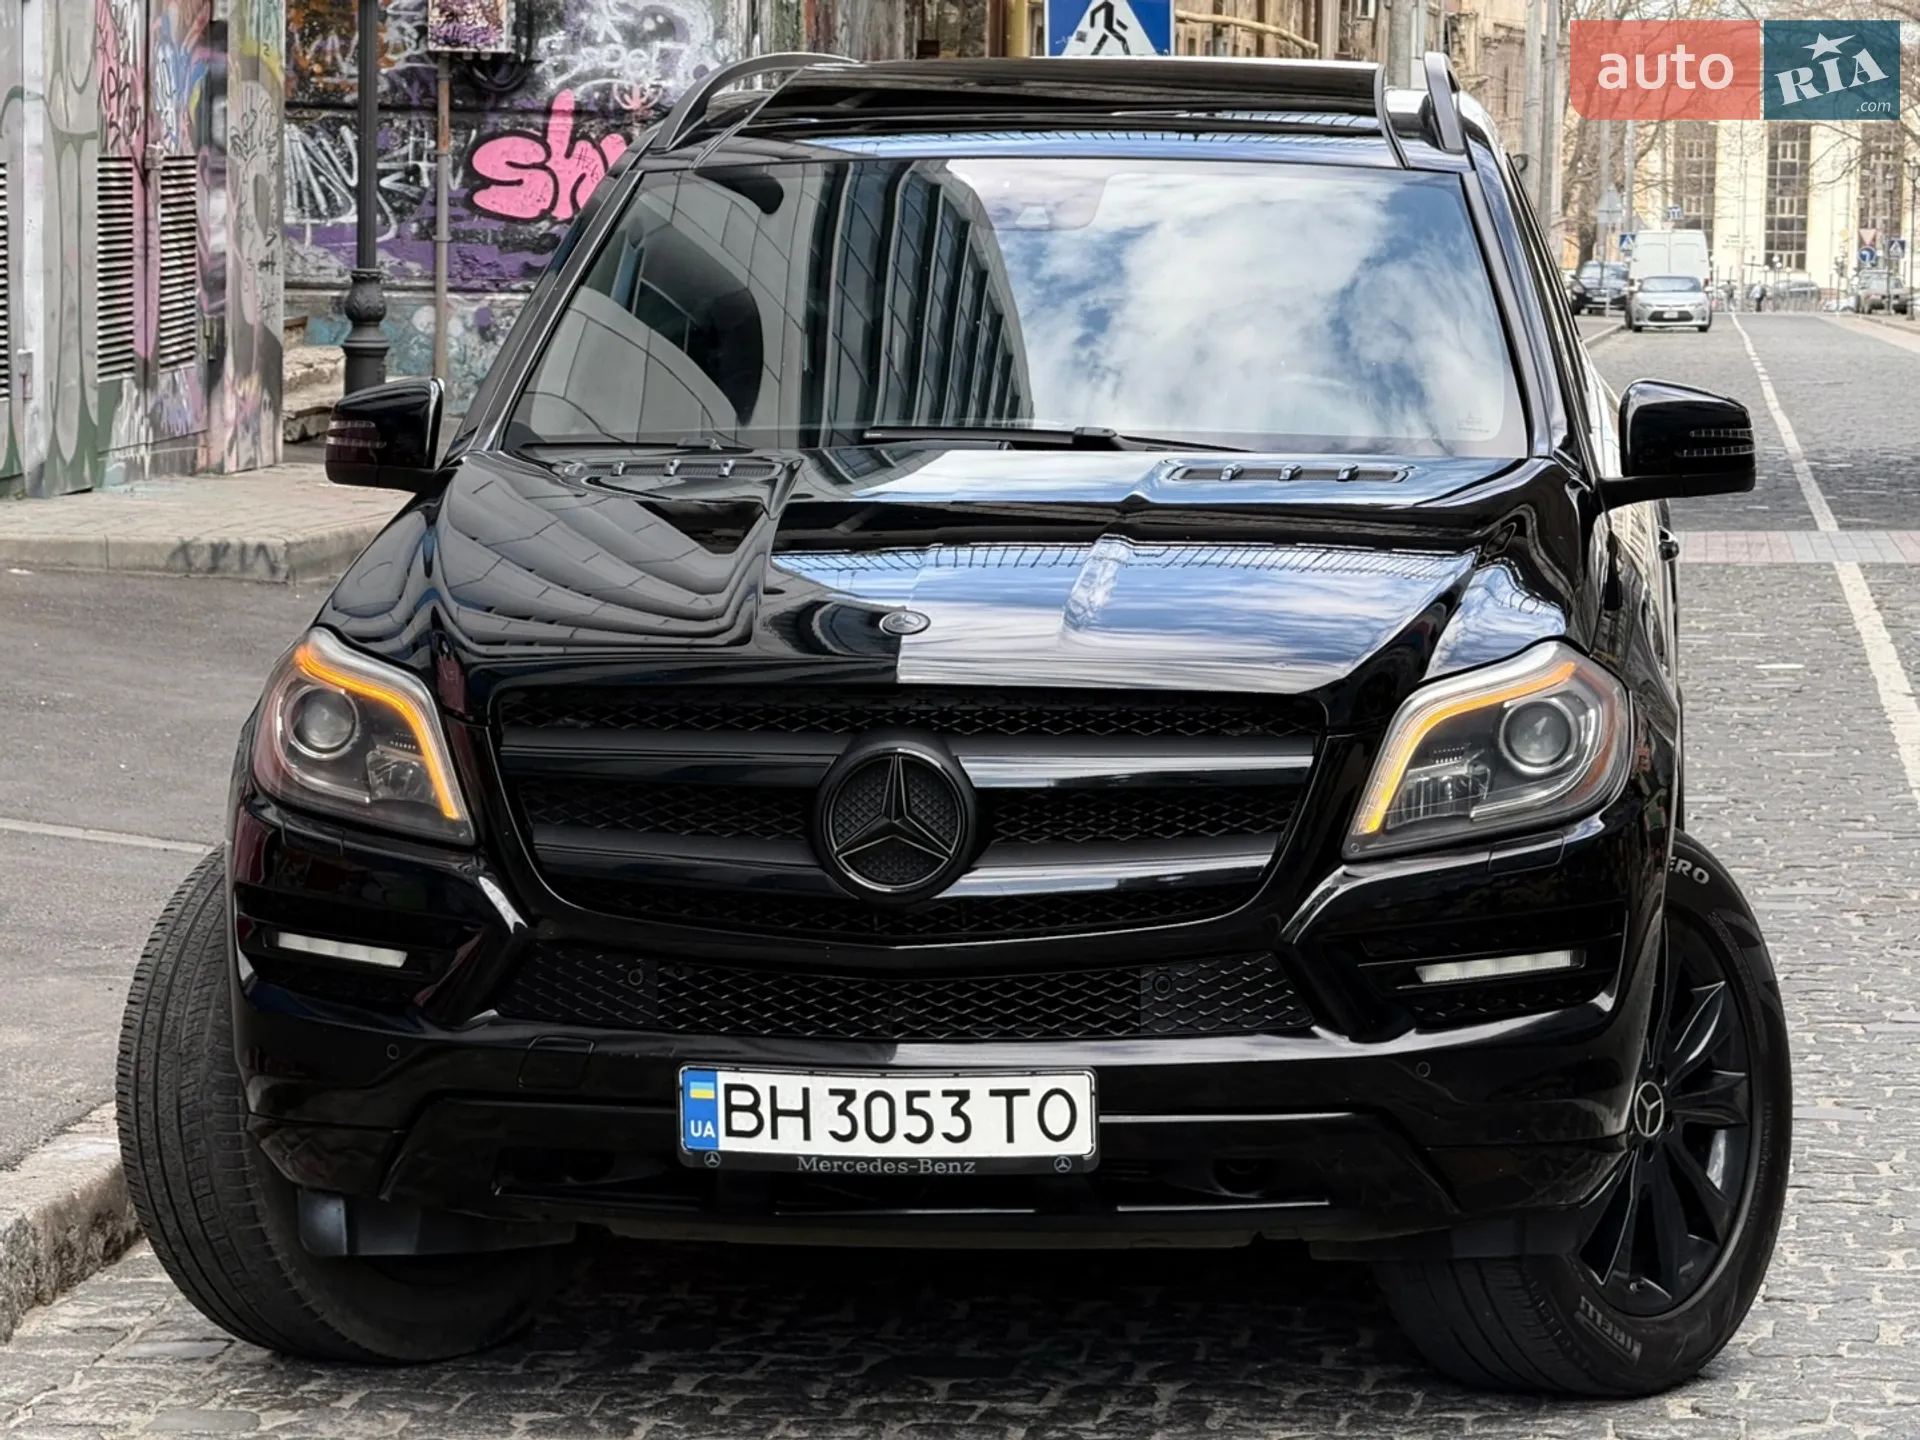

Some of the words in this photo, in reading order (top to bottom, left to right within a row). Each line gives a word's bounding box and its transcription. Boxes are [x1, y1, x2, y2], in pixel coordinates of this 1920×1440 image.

[723, 1082, 812, 1141] BH
[827, 1087, 973, 1145] 3053
[988, 1087, 1079, 1145] TO
[690, 1119, 716, 1138] UA
[796, 1155, 977, 1175] Mercedes-Benz
